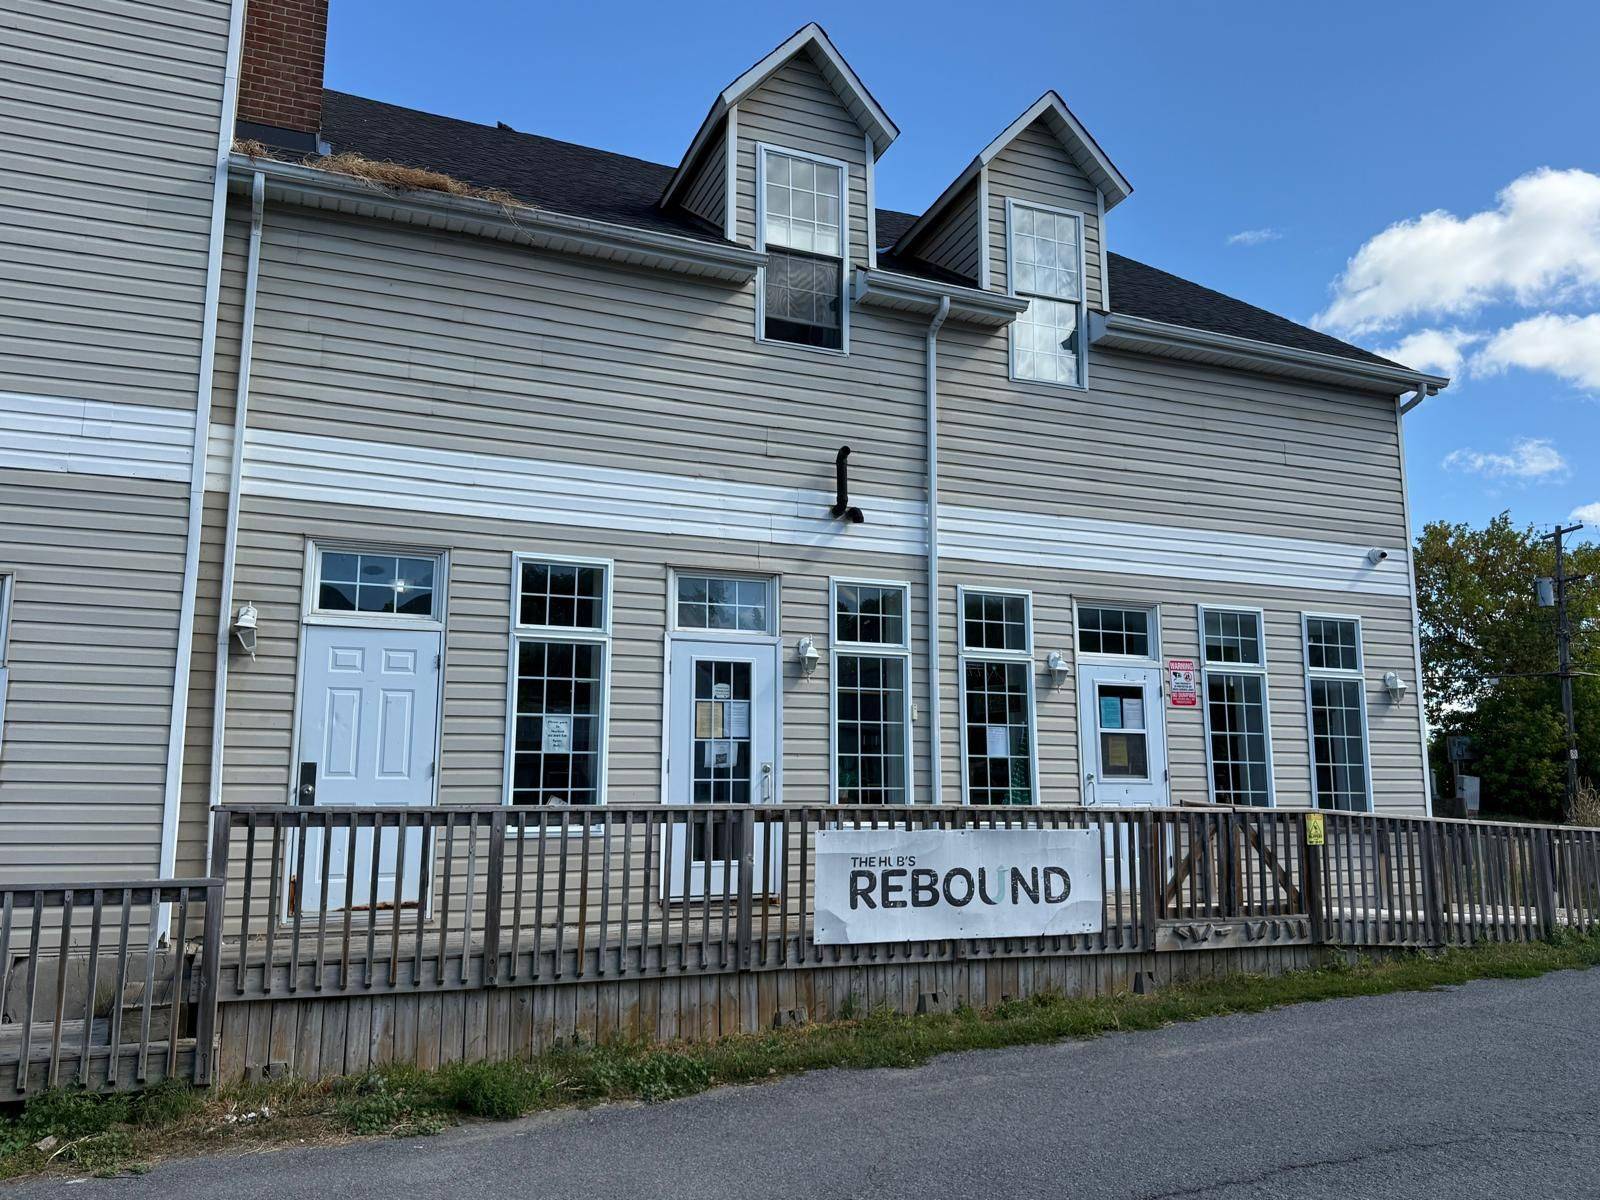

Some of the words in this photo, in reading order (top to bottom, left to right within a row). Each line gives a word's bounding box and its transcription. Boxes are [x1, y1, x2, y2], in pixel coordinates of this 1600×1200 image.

[1169, 662, 1193, 670] WARNING
[851, 856, 876, 867] THE
[850, 864, 1071, 910] REBOUND
